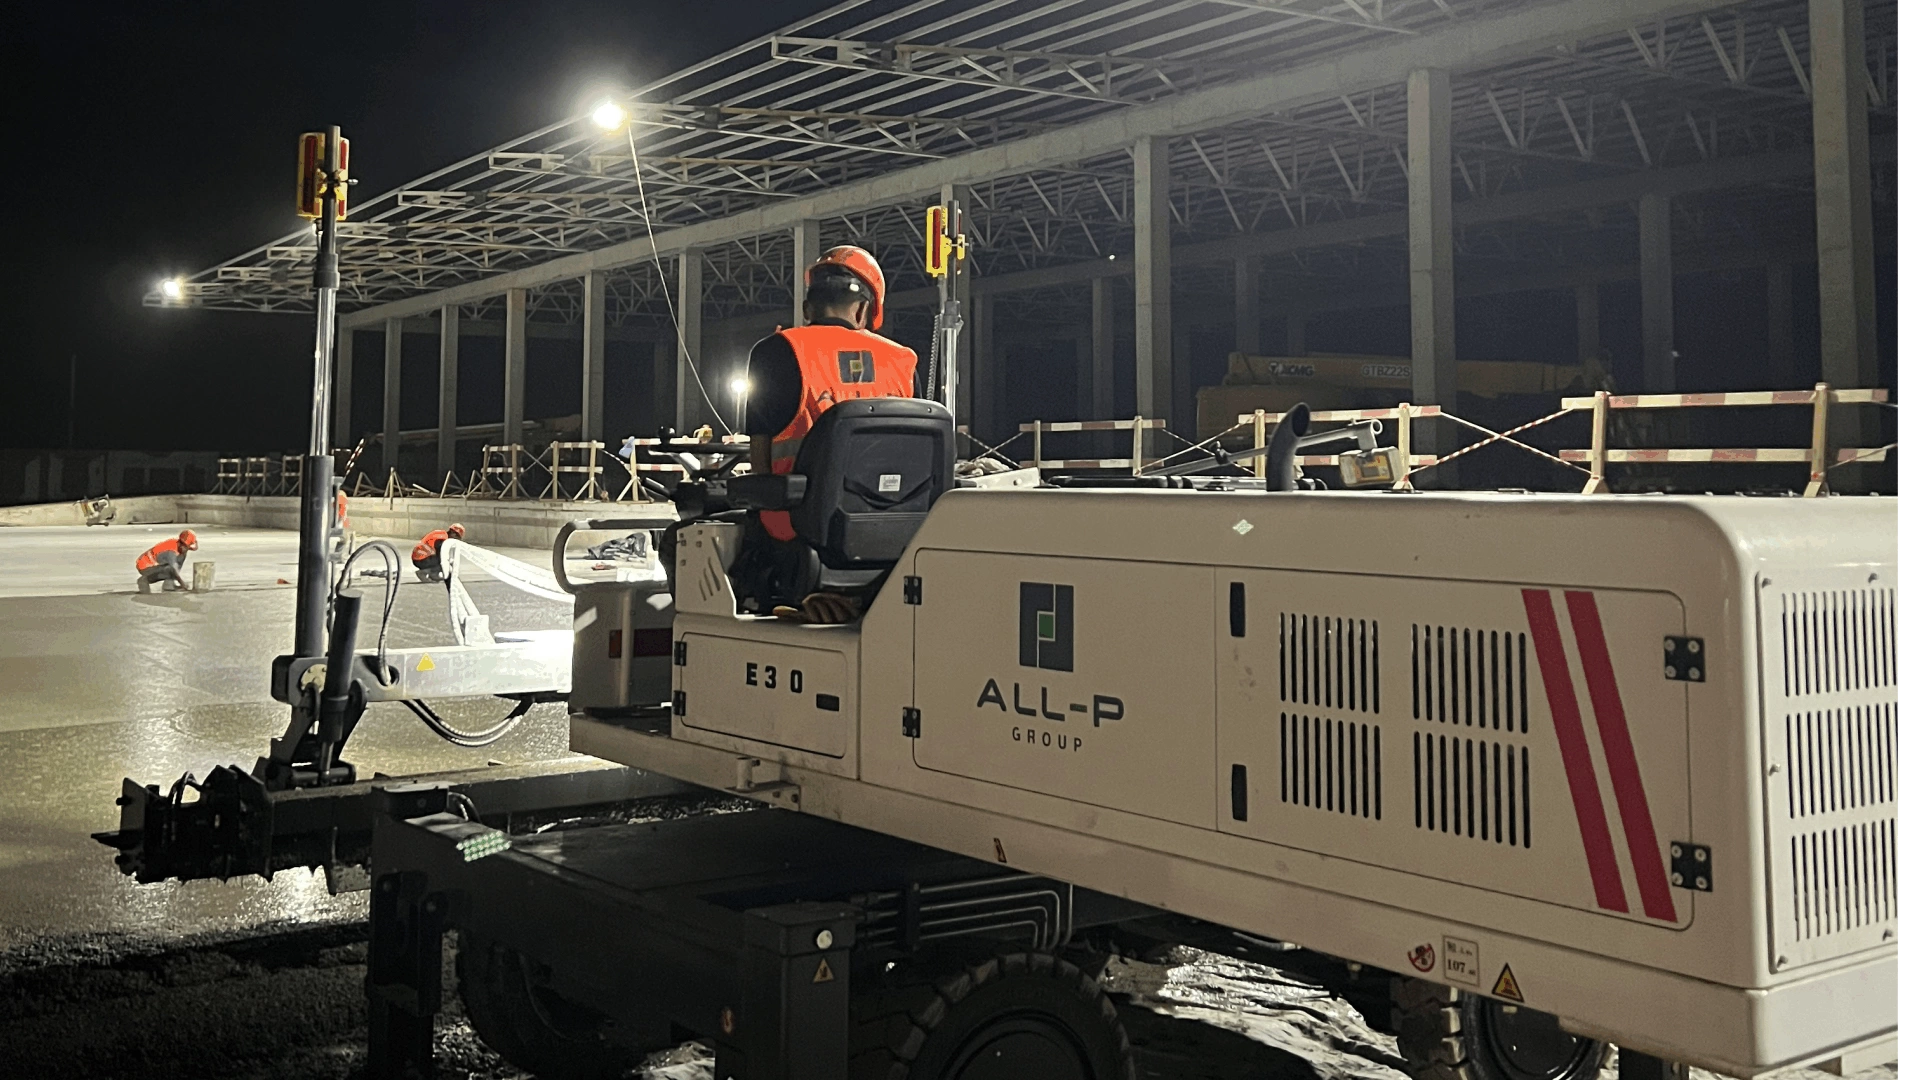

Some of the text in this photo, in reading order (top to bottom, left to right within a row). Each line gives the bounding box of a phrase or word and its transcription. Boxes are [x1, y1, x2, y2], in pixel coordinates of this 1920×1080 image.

[976, 678, 1125, 728] ALL-P
[1012, 726, 1083, 752] GROUP
[1447, 959, 1466, 973] 107
